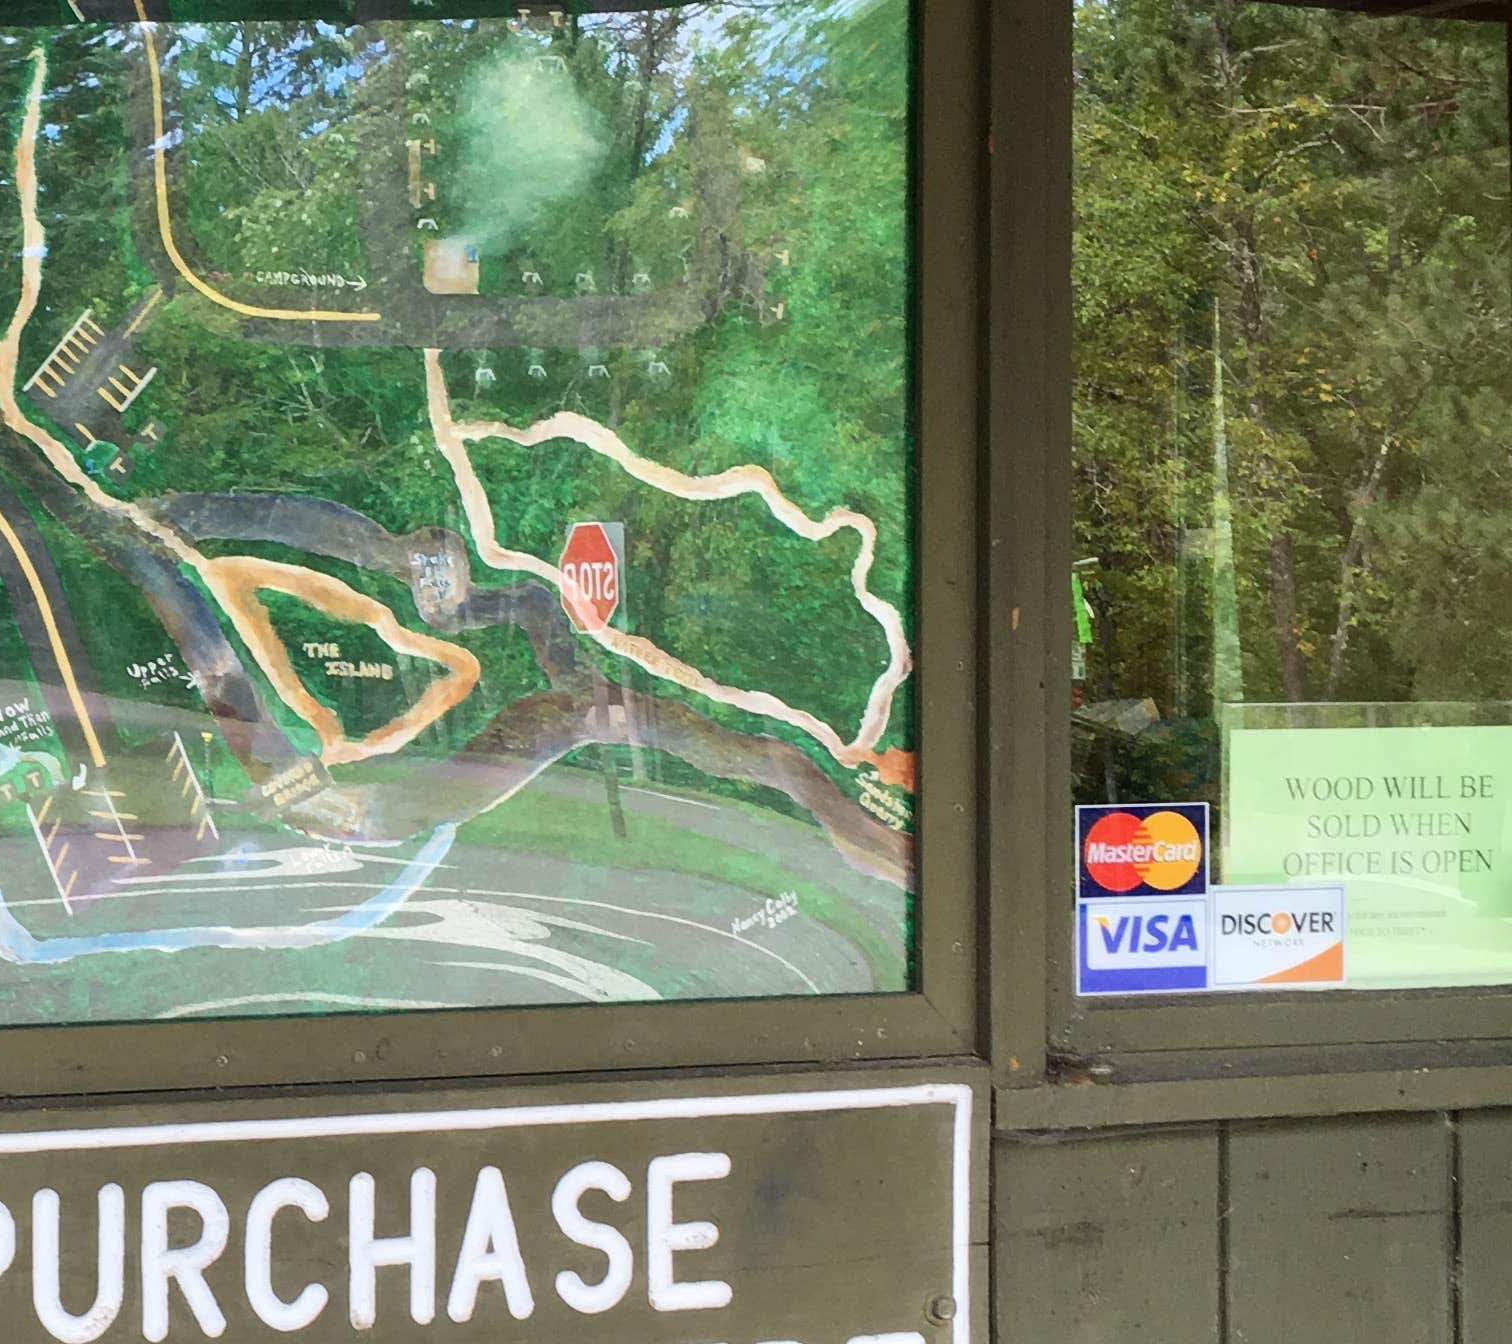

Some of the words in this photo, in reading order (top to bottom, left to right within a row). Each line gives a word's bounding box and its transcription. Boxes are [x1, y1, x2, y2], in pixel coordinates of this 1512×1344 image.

[256, 270, 345, 288] CAMPGROUND
[302, 642, 340, 659] THE
[126, 653, 173, 679] Upper
[324, 661, 393, 680] ISLAND
[1285, 776, 1374, 800] WOOD
[1384, 775, 1450, 799] WILL
[1460, 775, 1494, 798] BE
[1307, 814, 1381, 839] SOLD
[1390, 812, 1472, 836] WHEN
[1087, 839, 1198, 864] MasterCard
[1283, 850, 1381, 877] OFFICE
[1391, 851, 1413, 874] IS
[1422, 849, 1494, 874] OPEN
[1094, 914, 1199, 954] VISA
[1221, 911, 1334, 936] DISCOVER
[1252, 938, 1305, 948] NETWORK
